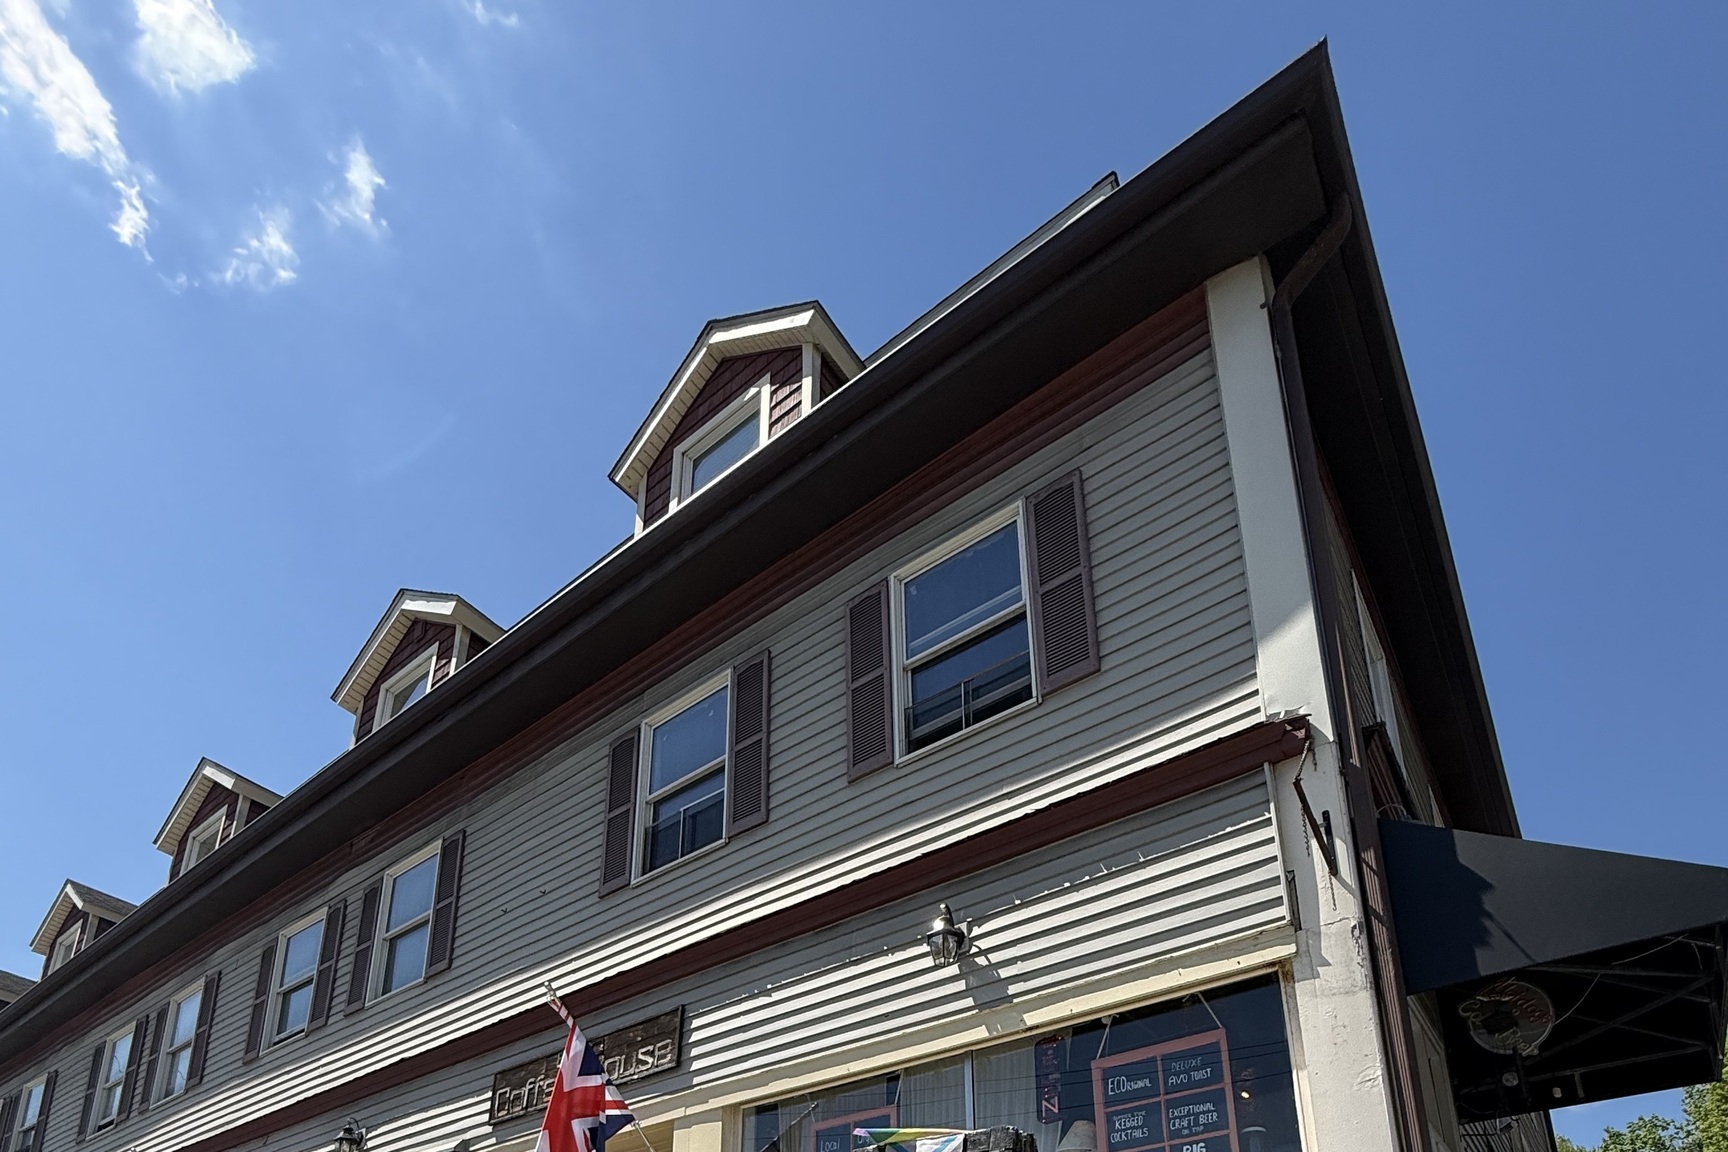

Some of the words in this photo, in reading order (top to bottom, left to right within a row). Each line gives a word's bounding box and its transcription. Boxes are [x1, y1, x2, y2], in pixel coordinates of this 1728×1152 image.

[1171, 1057, 1201, 1072] DELUXE
[1168, 1074, 1188, 1086] AVO
[1190, 1067, 1211, 1081] TOAST
[1169, 1102, 1216, 1118] EXCEPTIONAL
[1115, 1115, 1144, 1130] KEGGED
[1170, 1116, 1195, 1130] CRAFT
[1199, 1112, 1218, 1125] BEER
[1110, 1127, 1149, 1143] COCKTAILS
